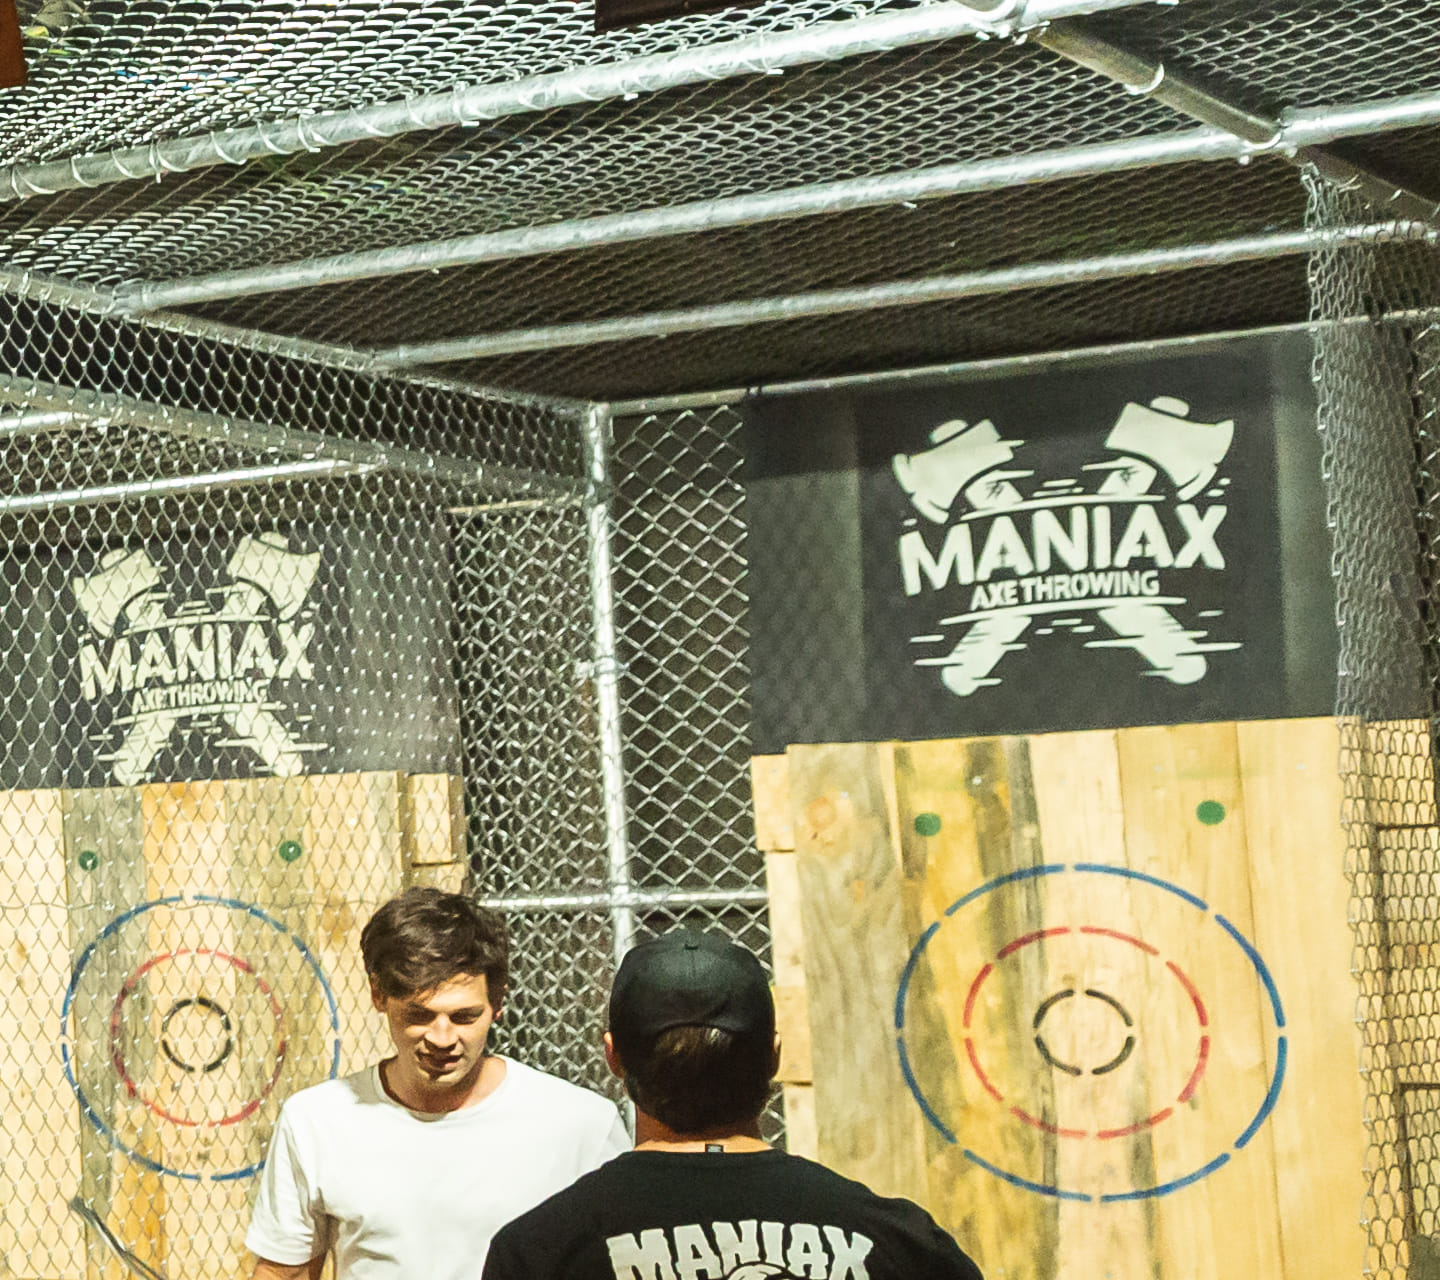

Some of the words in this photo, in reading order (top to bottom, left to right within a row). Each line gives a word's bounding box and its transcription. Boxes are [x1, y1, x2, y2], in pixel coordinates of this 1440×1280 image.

[898, 503, 1228, 597] MANIAX
[970, 578, 1019, 612] AXE
[1019, 569, 1161, 602] THROWING
[79, 621, 317, 701] MANIAX
[131, 688, 167, 715] AXE
[167, 677, 270, 708] THROWING
